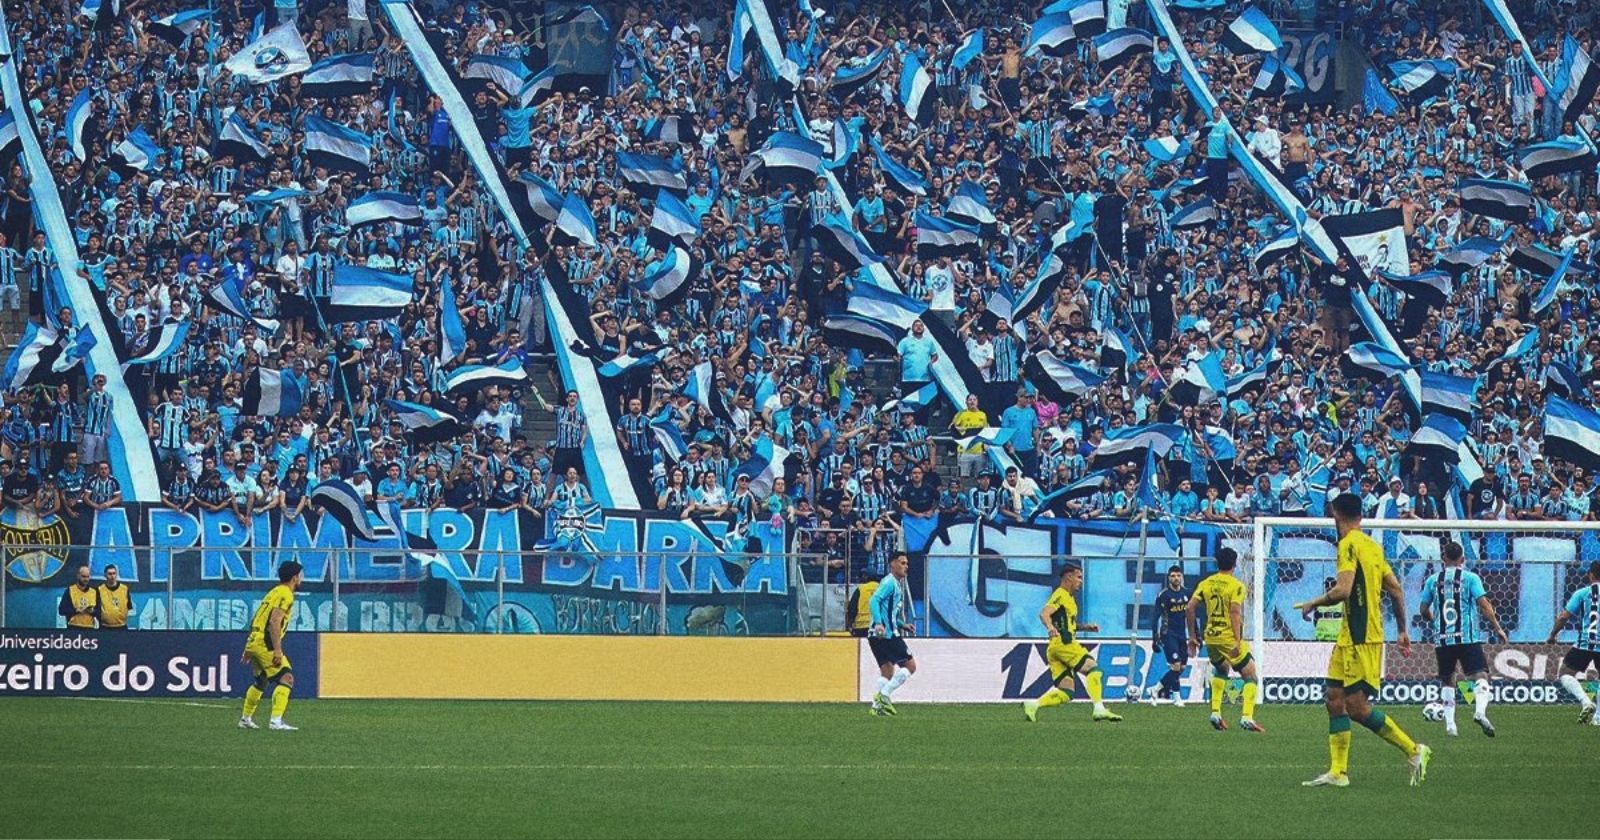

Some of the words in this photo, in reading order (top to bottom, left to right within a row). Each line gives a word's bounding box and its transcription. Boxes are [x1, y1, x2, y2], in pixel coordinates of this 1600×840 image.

[86, 507, 139, 582] A
[1442, 599, 1458, 625] 6
[102, 653, 155, 691] do
[166, 654, 232, 692] Sul
[1265, 683, 1323, 701] COOB
